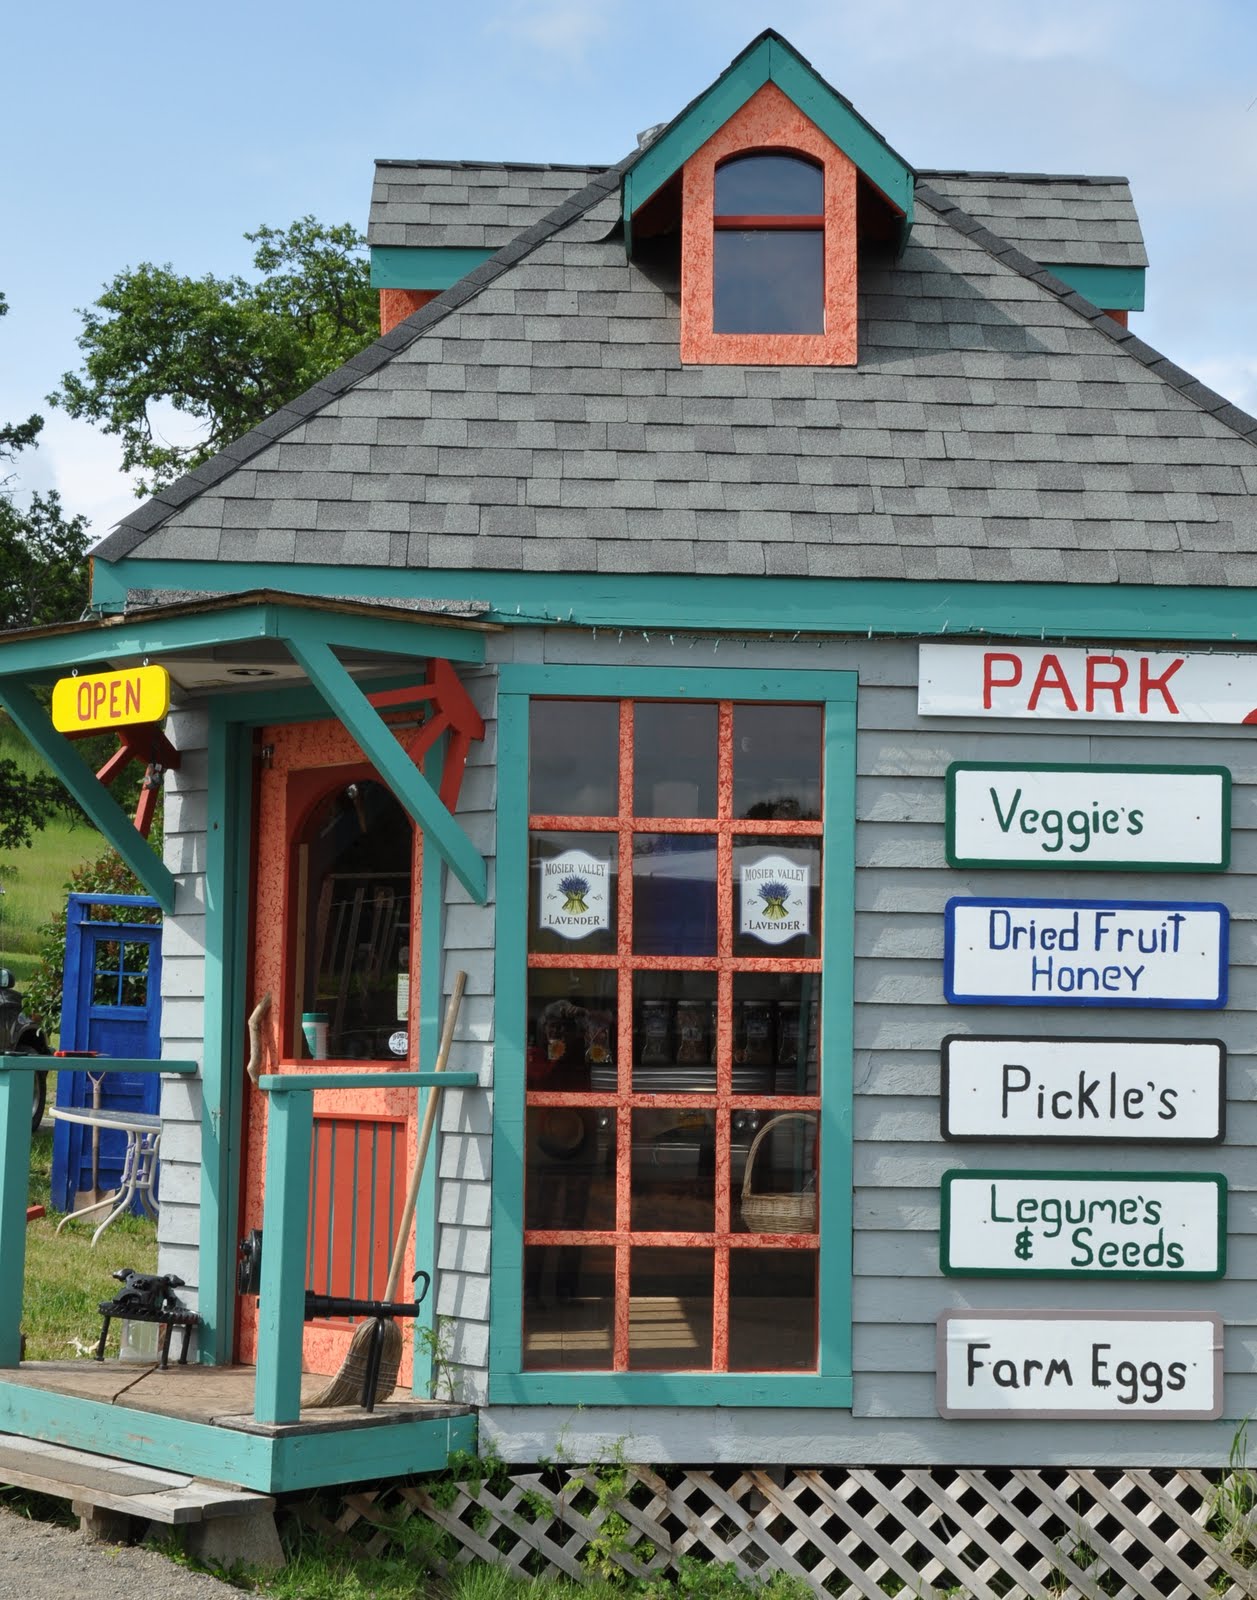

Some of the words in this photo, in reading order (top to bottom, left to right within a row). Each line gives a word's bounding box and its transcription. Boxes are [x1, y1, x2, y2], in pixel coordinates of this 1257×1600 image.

[77, 678, 141, 721] OPEN
[983, 653, 1185, 714] PARK
[990, 787, 1144, 853] Veggie's
[545, 863, 575, 876] MOSIER
[578, 864, 606, 876] VALLEY
[745, 869, 774, 881] MOSIER
[778, 869, 805, 881] VALLEY
[548, 914, 600, 925] LAVENDER
[749, 919, 801, 930] LAVENDER
[989, 909, 1079, 951] Dried
[1095, 911, 1186, 953] Fruit
[1032, 956, 1145, 992] Honey
[1002, 1064, 1178, 1120] Pickle's
[991, 1184, 1163, 1237] Legume's
[1015, 1226, 1034, 1261] &
[1071, 1227, 1185, 1269] Seeds
[967, 1343, 1073, 1389] Farm
[1092, 1343, 1187, 1405] Eggs
